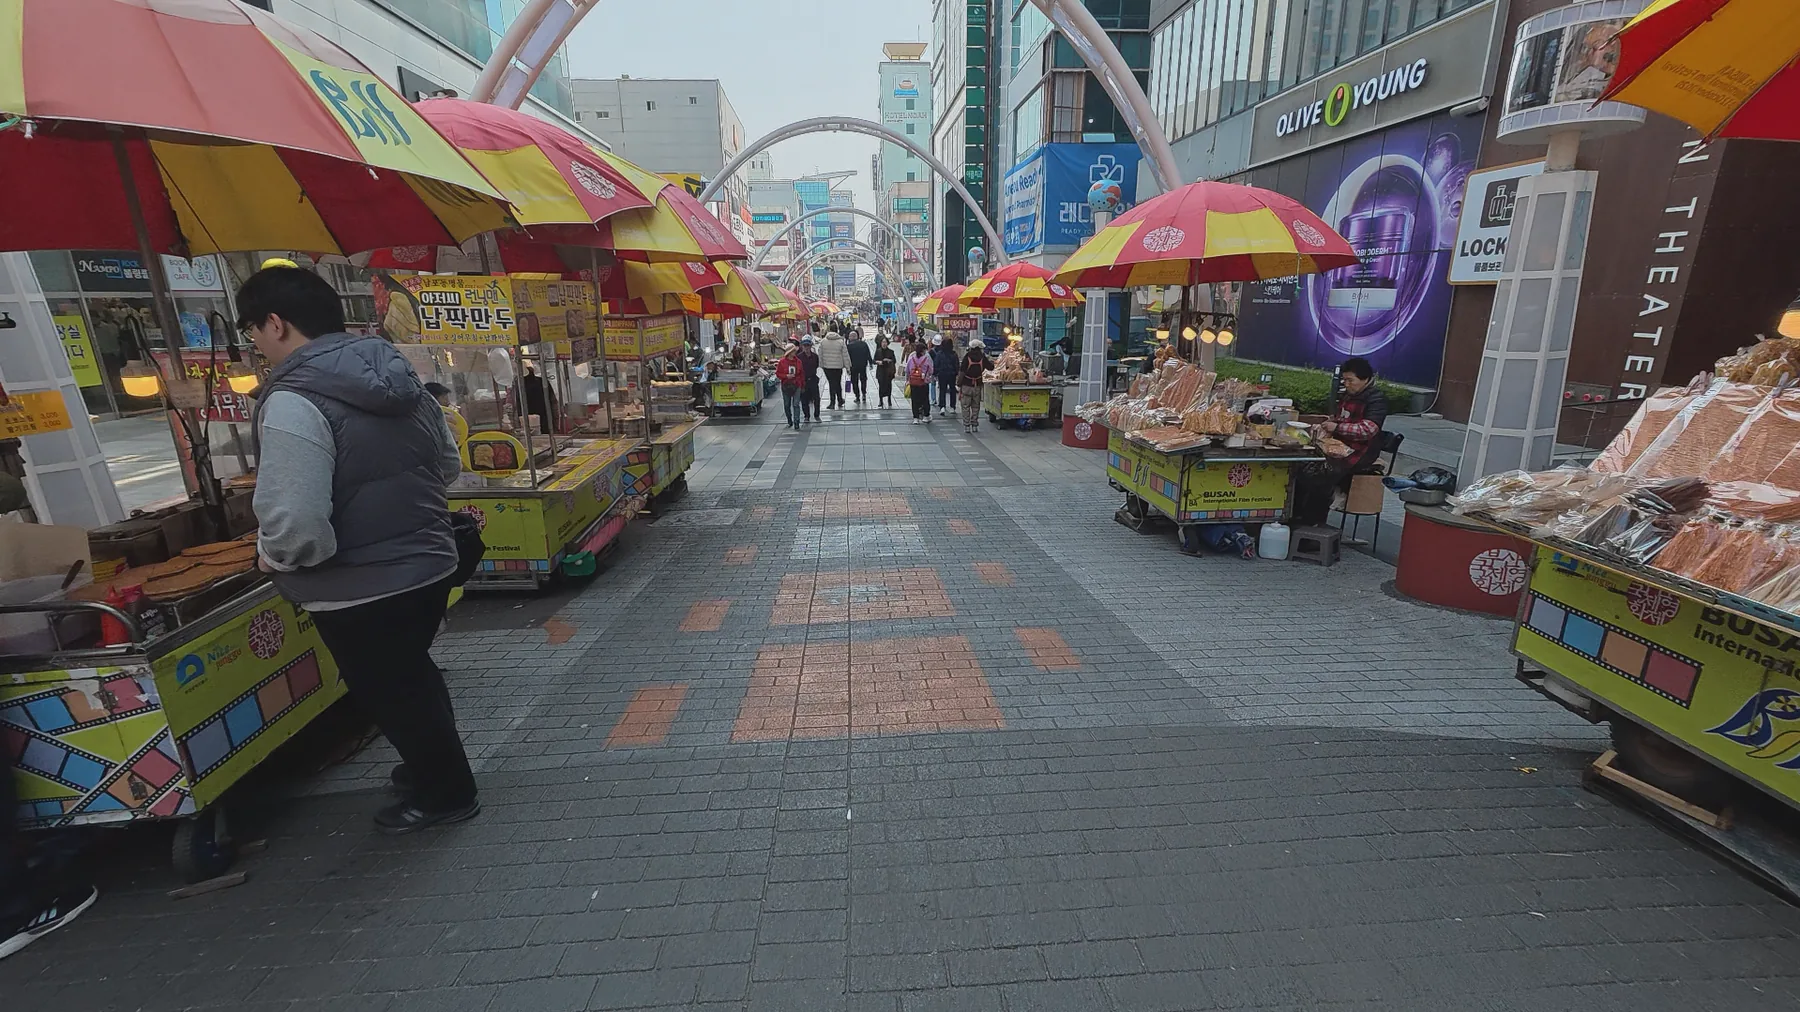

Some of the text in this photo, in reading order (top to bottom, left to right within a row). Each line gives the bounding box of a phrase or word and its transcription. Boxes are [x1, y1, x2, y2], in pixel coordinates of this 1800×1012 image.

[1276, 58, 1428, 138] OLIVE YOUNG
[421, 292, 460, 305] 아저씨
[465, 289, 499, 306] 런닝맨
[1617, 196, 1699, 402] THEATER
[56, 324, 81, 340] 장실
